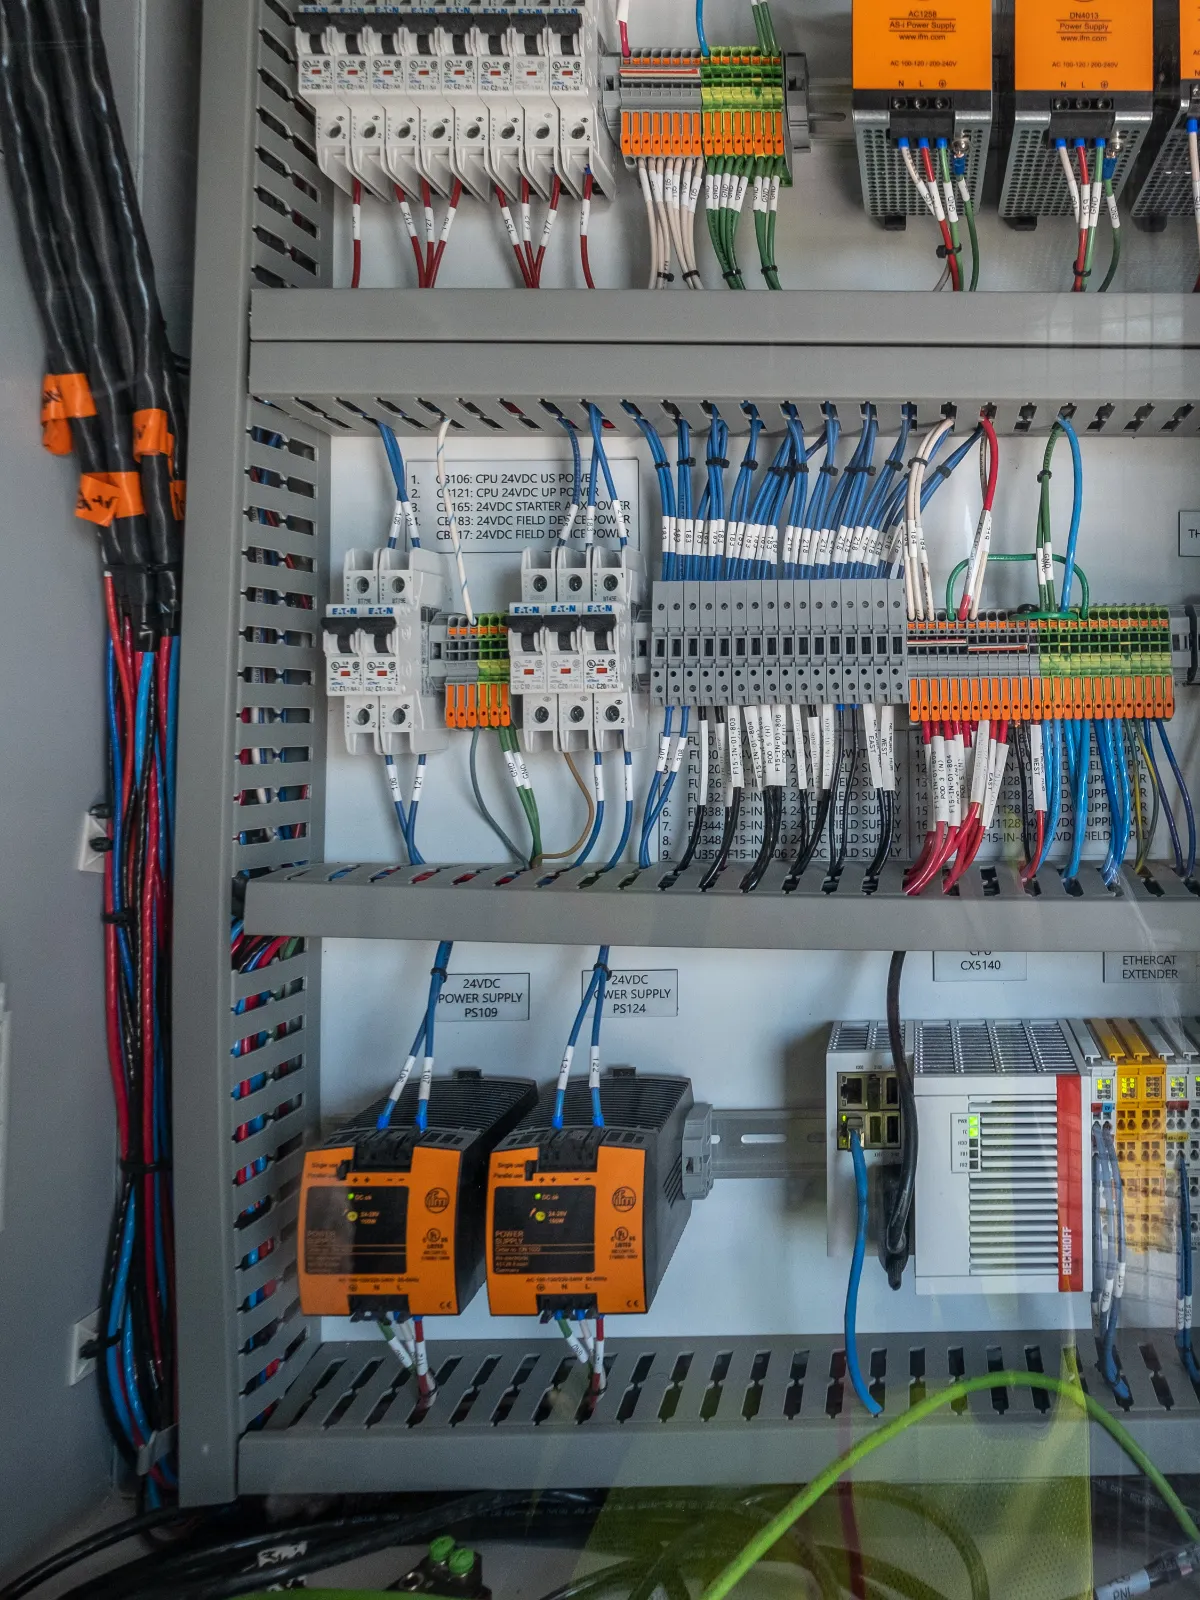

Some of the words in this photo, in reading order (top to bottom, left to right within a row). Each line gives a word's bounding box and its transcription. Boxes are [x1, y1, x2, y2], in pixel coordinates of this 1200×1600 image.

[908, 10, 937, 18] AC1258
[906, 21, 929, 29] Power
[931, 21, 955, 31] Supply
[1059, 22, 1081, 30] Power
[1084, 22, 1109, 31] Supply
[948, 195, 956, 213] GND
[1090, 196, 1098, 215] GND
[403, 211, 412, 226] 112
[1111, 205, 1119, 221] GND
[504, 218, 516, 235] 159
[411, 475, 420, 484] 1.
[475, 474, 498, 484] CPU
[501, 473, 538, 484] 24VDC
[541, 473, 556, 483] US
[411, 489, 420, 498] 2.
[476, 488, 499, 498] CPU
[501, 487, 538, 498] 24VDC
[541, 488, 557, 497] UP
[476, 502, 512, 512] 24VDC
[515, 501, 561, 511] STARTER
[477, 516, 513, 526] 24VDC
[516, 515, 546, 525] FIELD
[436, 530, 473, 540] CB17:
[476, 529, 512, 540] 24VDC
[515, 529, 545, 539] FIELD
[729, 717, 739, 775] F15-IN-01-803
[869, 735, 877, 753] EAST
[662, 807, 671, 816] 6.
[662, 822, 671, 831] 7.
[662, 836, 671, 845] 8.
[662, 851, 671, 860] 9.
[960, 961, 1001, 970] CX5140
[1122, 955, 1177, 966] ETHERCAT
[611, 974, 649, 985] 24VDC
[1122, 969, 1178, 979] EXTENDER
[463, 978, 501, 989] 24VDC
[438, 993, 483, 1004] POWER
[485, 993, 523, 1004] SUPPLY
[631, 988, 671, 1000] SUPPLY
[464, 1008, 498, 1018] PS109
[612, 1004, 646, 1014] PS124
[1062, 1226, 1073, 1275] BECKHOFF
